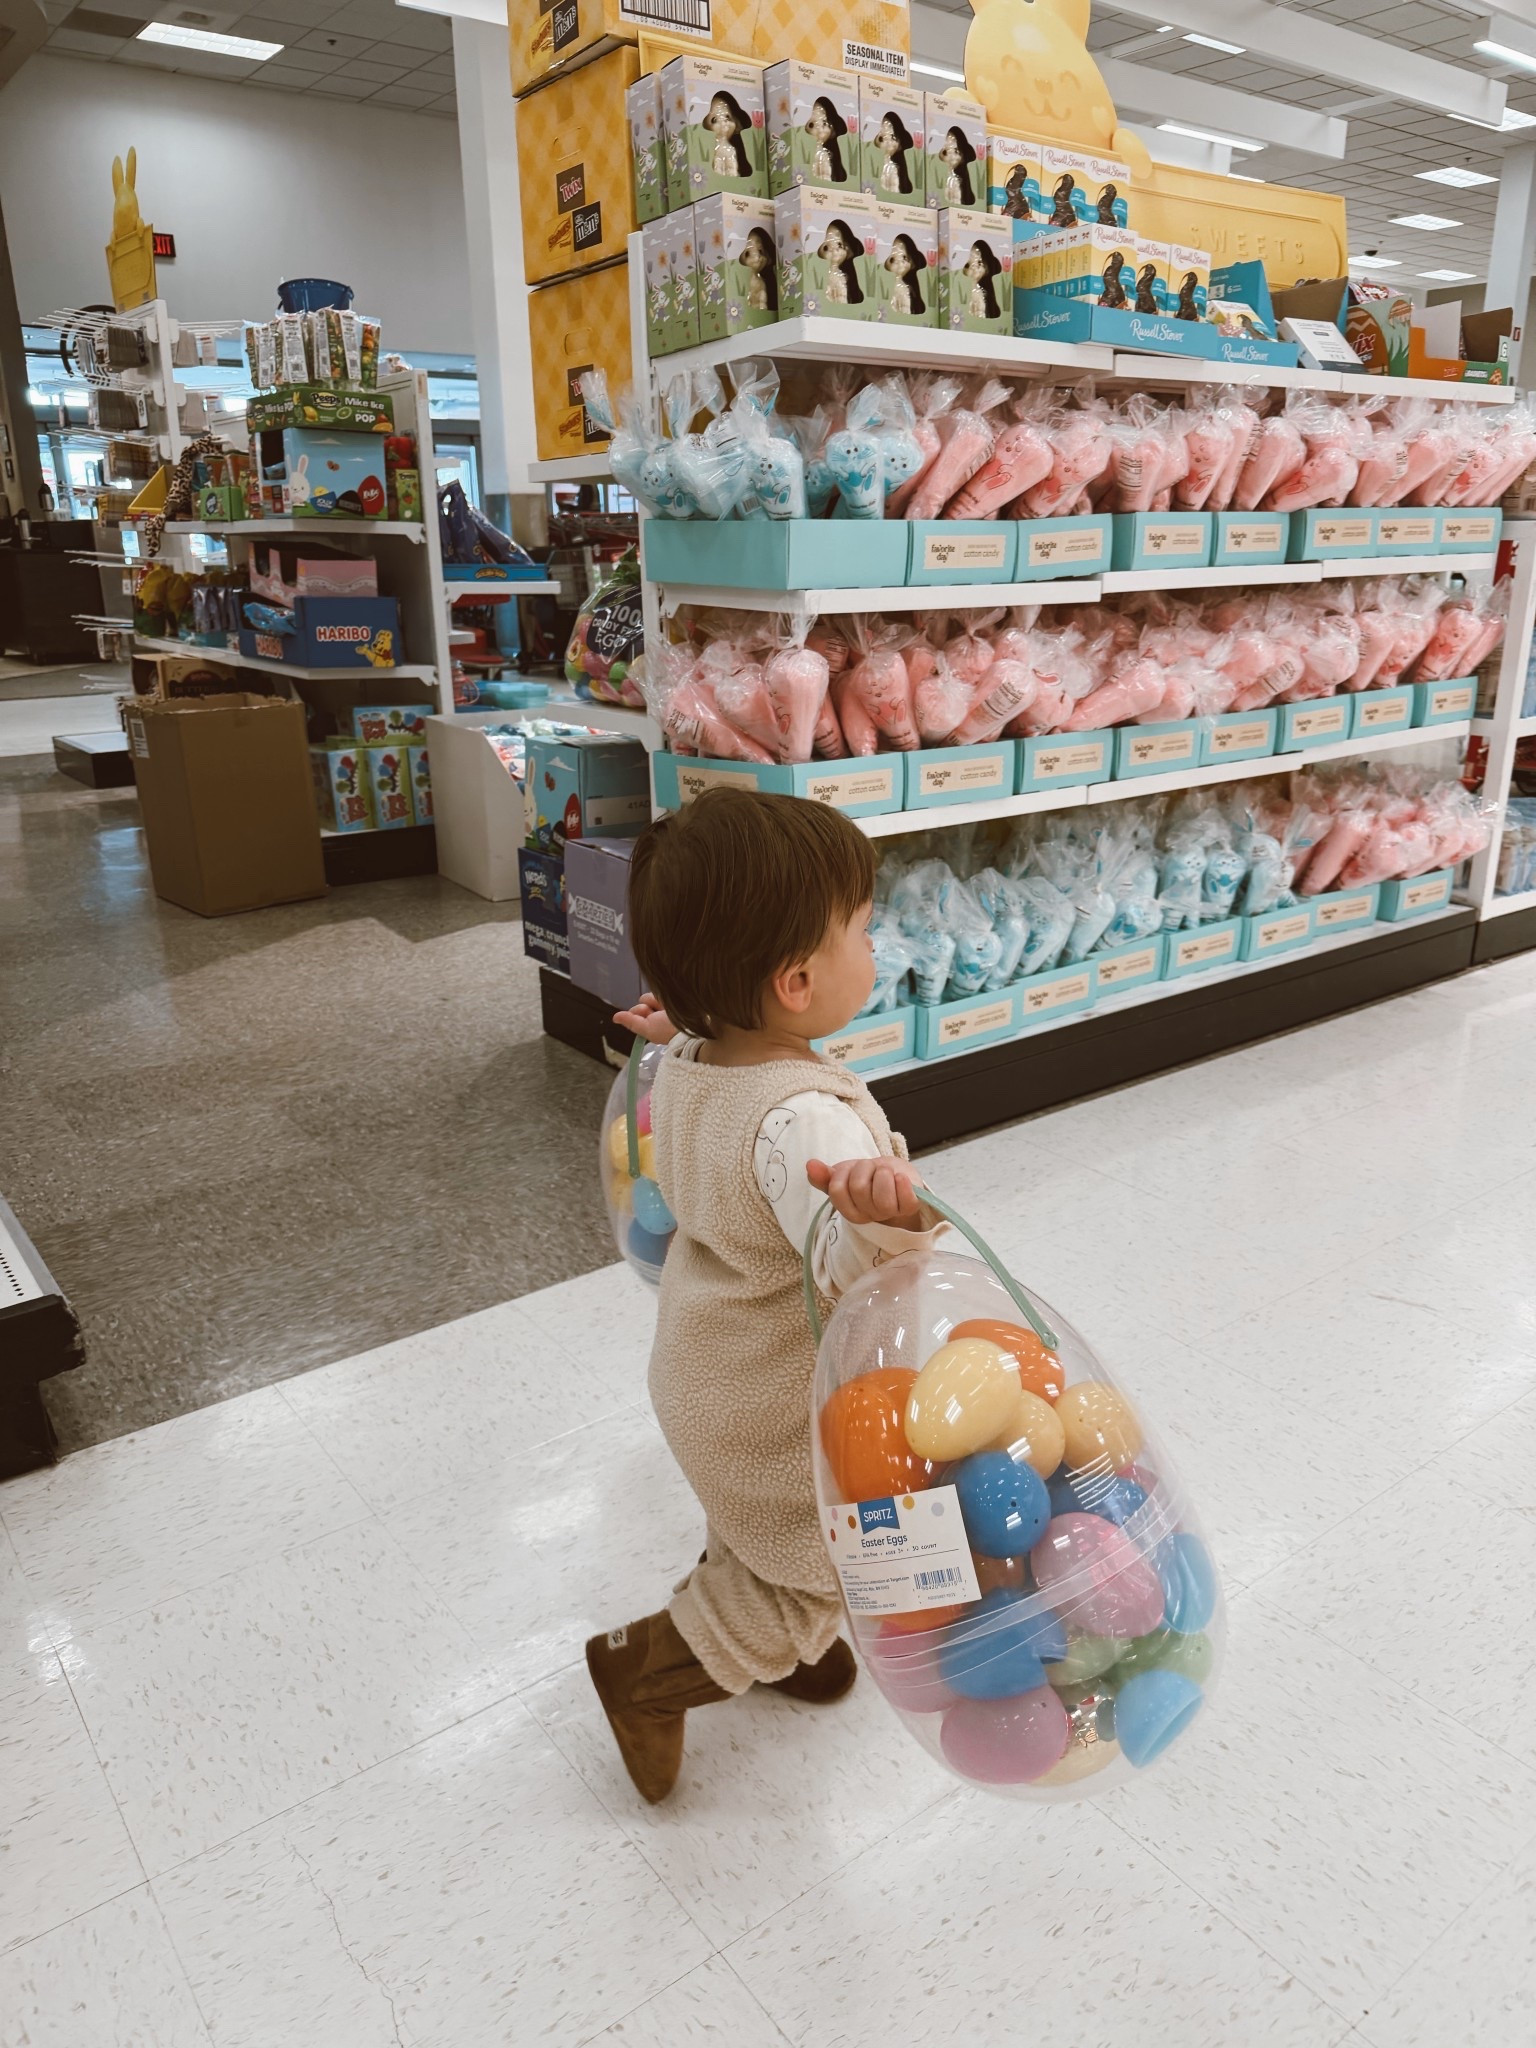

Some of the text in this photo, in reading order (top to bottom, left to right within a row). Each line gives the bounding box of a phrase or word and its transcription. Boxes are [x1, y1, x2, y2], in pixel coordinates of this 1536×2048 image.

[847, 43, 903, 66] SEASONAL ITEM
[845, 56, 906, 77] DISPLAY IMMEDIATELY
[996, 140, 1039, 158] Russell Stover
[1046, 150, 1086, 169] Russell Stover
[1090, 160, 1128, 179] Russell Stover
[1095, 227, 1135, 246] Russell Stover
[1137, 243, 1167, 257] ussell Stover
[1191, 226, 1304, 264] SWEETS
[1175, 248, 1209, 266] Russell Stover
[1013, 310, 1071, 336] Russell Stover
[1130, 318, 1184, 342] Russell Stover
[1222, 343, 1269, 363] Russell Stover
[1500, 341, 1507, 357] 6
[312, 392, 341, 405] Peeps
[345, 397, 385, 410] Mike Ike
[355, 413, 376, 424] POP
[931, 544, 955, 553] favorite
[1035, 541, 1057, 552] favorite
[936, 552, 948, 562] day
[964, 550, 1000, 558] cotton candy
[1040, 550, 1051, 559] day
[611, 605, 642, 626] 100
[317, 626, 371, 641] HARIBO
[683, 776, 706, 787] favorite
[926, 770, 952, 780] favorite
[960, 770, 998, 781] cotton candy
[813, 784, 839, 794] favorite
[848, 783, 887, 795] cotton candy
[932, 778, 944, 788] day
[820, 793, 832, 802] day
[829, 1043, 853, 1054] favorite
[835, 1052, 846, 1060] day
[863, 1508, 893, 1522] SPRITZ
[861, 1535, 908, 1548] Easter Eggs
